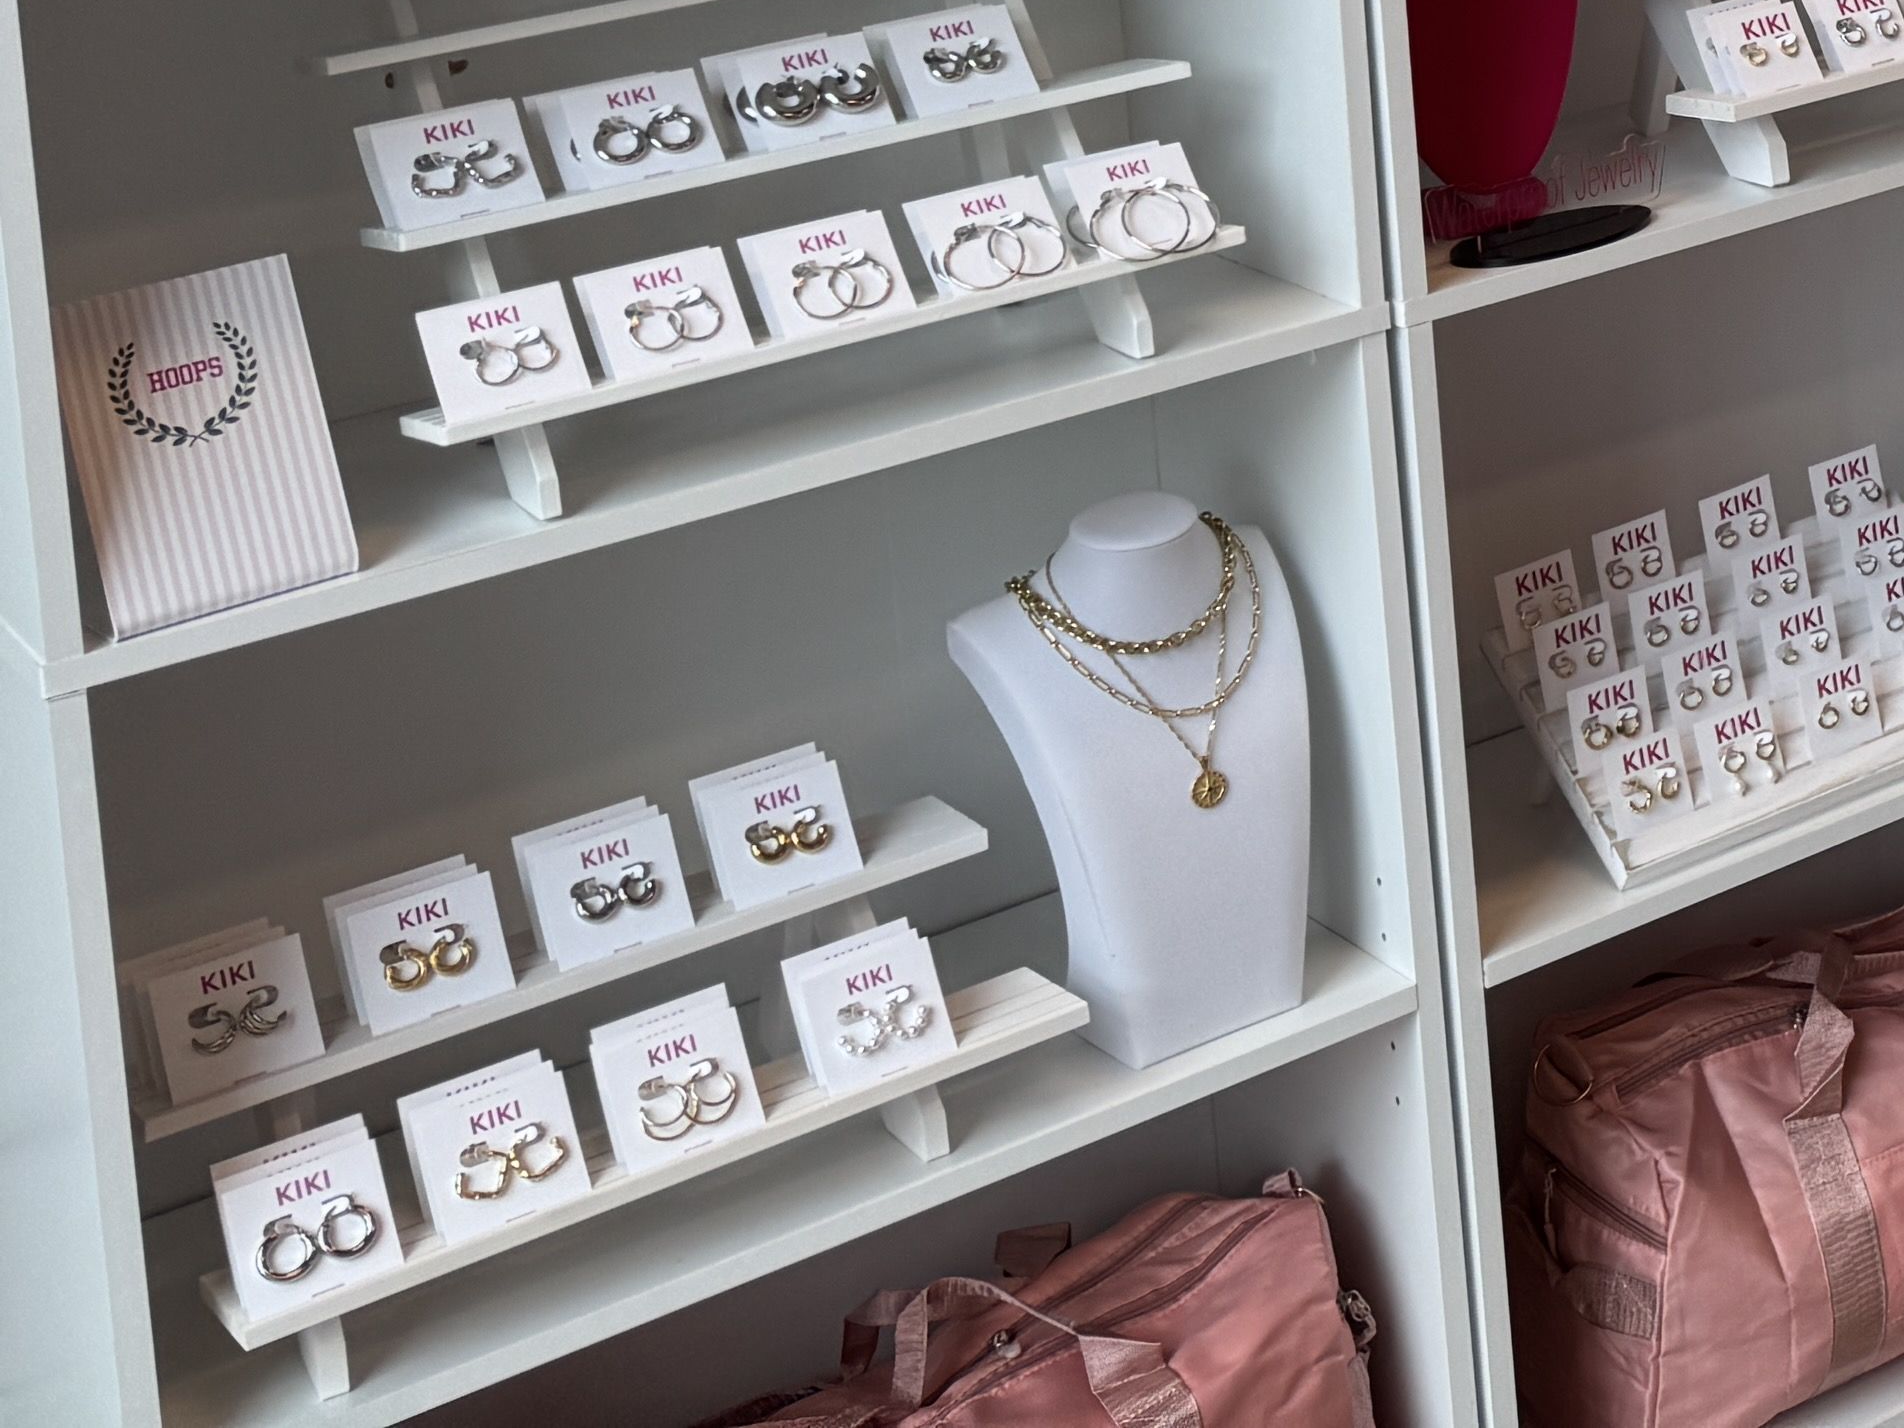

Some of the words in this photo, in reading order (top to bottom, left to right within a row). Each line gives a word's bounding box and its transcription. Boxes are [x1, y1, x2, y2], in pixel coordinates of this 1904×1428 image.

[929, 20, 975, 42] KIKI
[781, 49, 828, 72] KIKI
[607, 86, 656, 109] KIKI
[423, 119, 476, 143] KIKI
[1106, 159, 1149, 181] KIKI
[960, 194, 1007, 218] KIKI
[633, 267, 683, 292] KIKI
[467, 305, 520, 332] KIKI
[148, 356, 224, 394] HOOPS
[1826, 456, 1869, 487] KIKI
[1611, 522, 1658, 554] KIKI
[1857, 515, 1900, 547] KIKI
[1649, 582, 1695, 615] KIKI
[1683, 641, 1728, 675] KIKI
[1714, 708, 1762, 744] KIKI
[754, 784, 801, 814] KIKI
[580, 838, 630, 869] KIKI
[397, 898, 449, 931] KIKI
[201, 960, 255, 994] KIKI
[845, 963, 892, 995] KIKI
[647, 1034, 698, 1068] KIKI
[470, 1100, 523, 1135] KIKI
